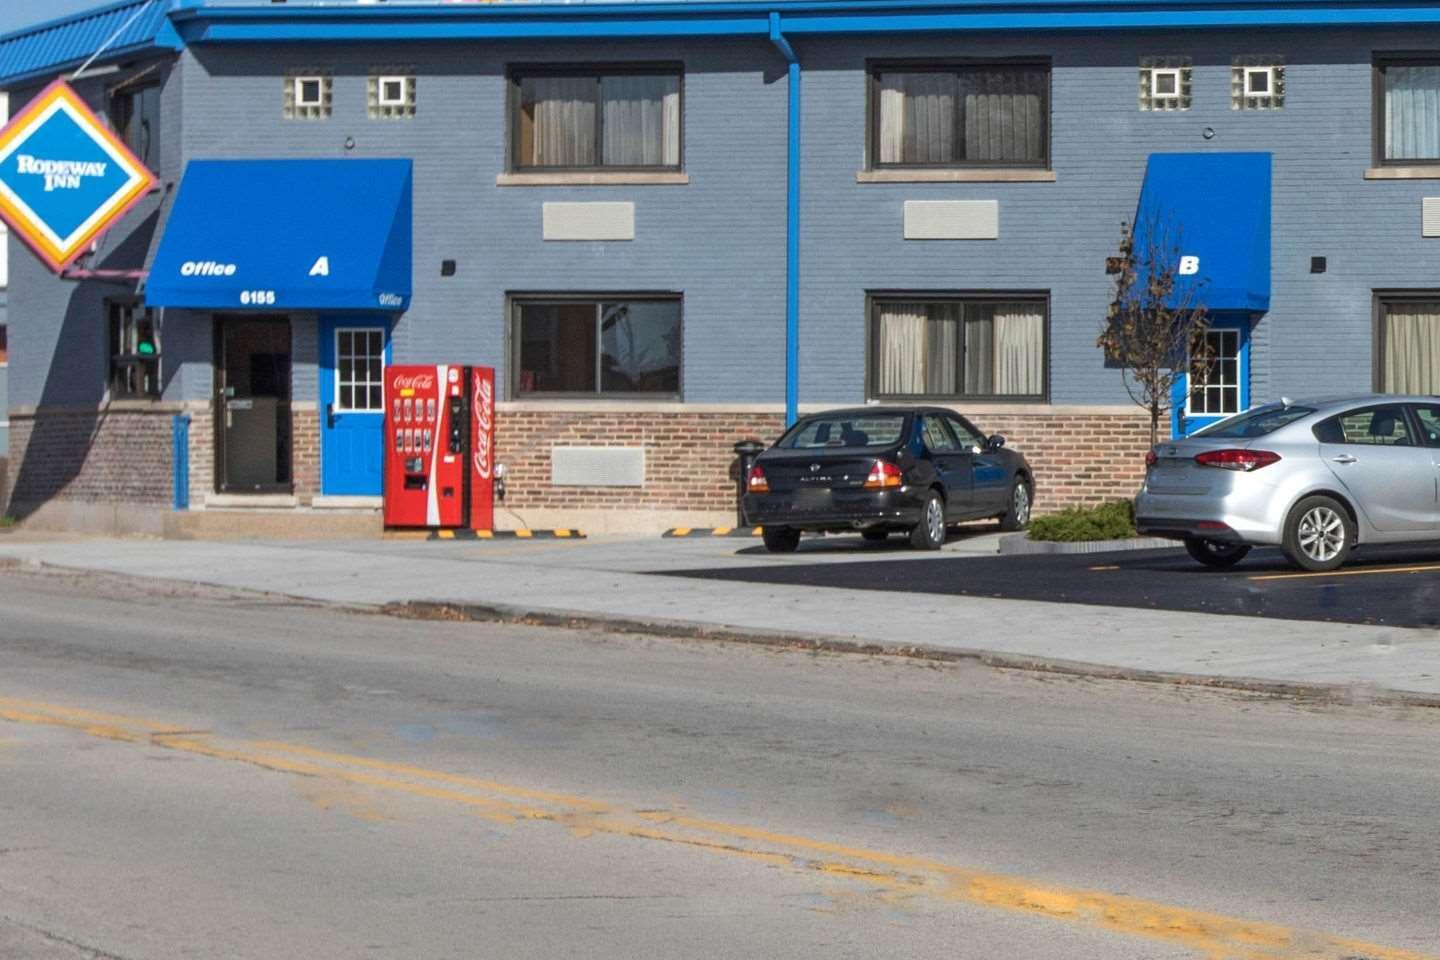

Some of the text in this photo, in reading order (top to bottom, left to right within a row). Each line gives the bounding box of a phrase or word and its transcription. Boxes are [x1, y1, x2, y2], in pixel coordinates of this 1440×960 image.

[16, 154, 107, 177] RODEWAY
[44, 174, 80, 192] INN
[180, 260, 236, 277] Office
[308, 255, 329, 276] A
[1178, 255, 1200, 275] B
[240, 290, 275, 305] 6155
[379, 292, 403, 306] Office
